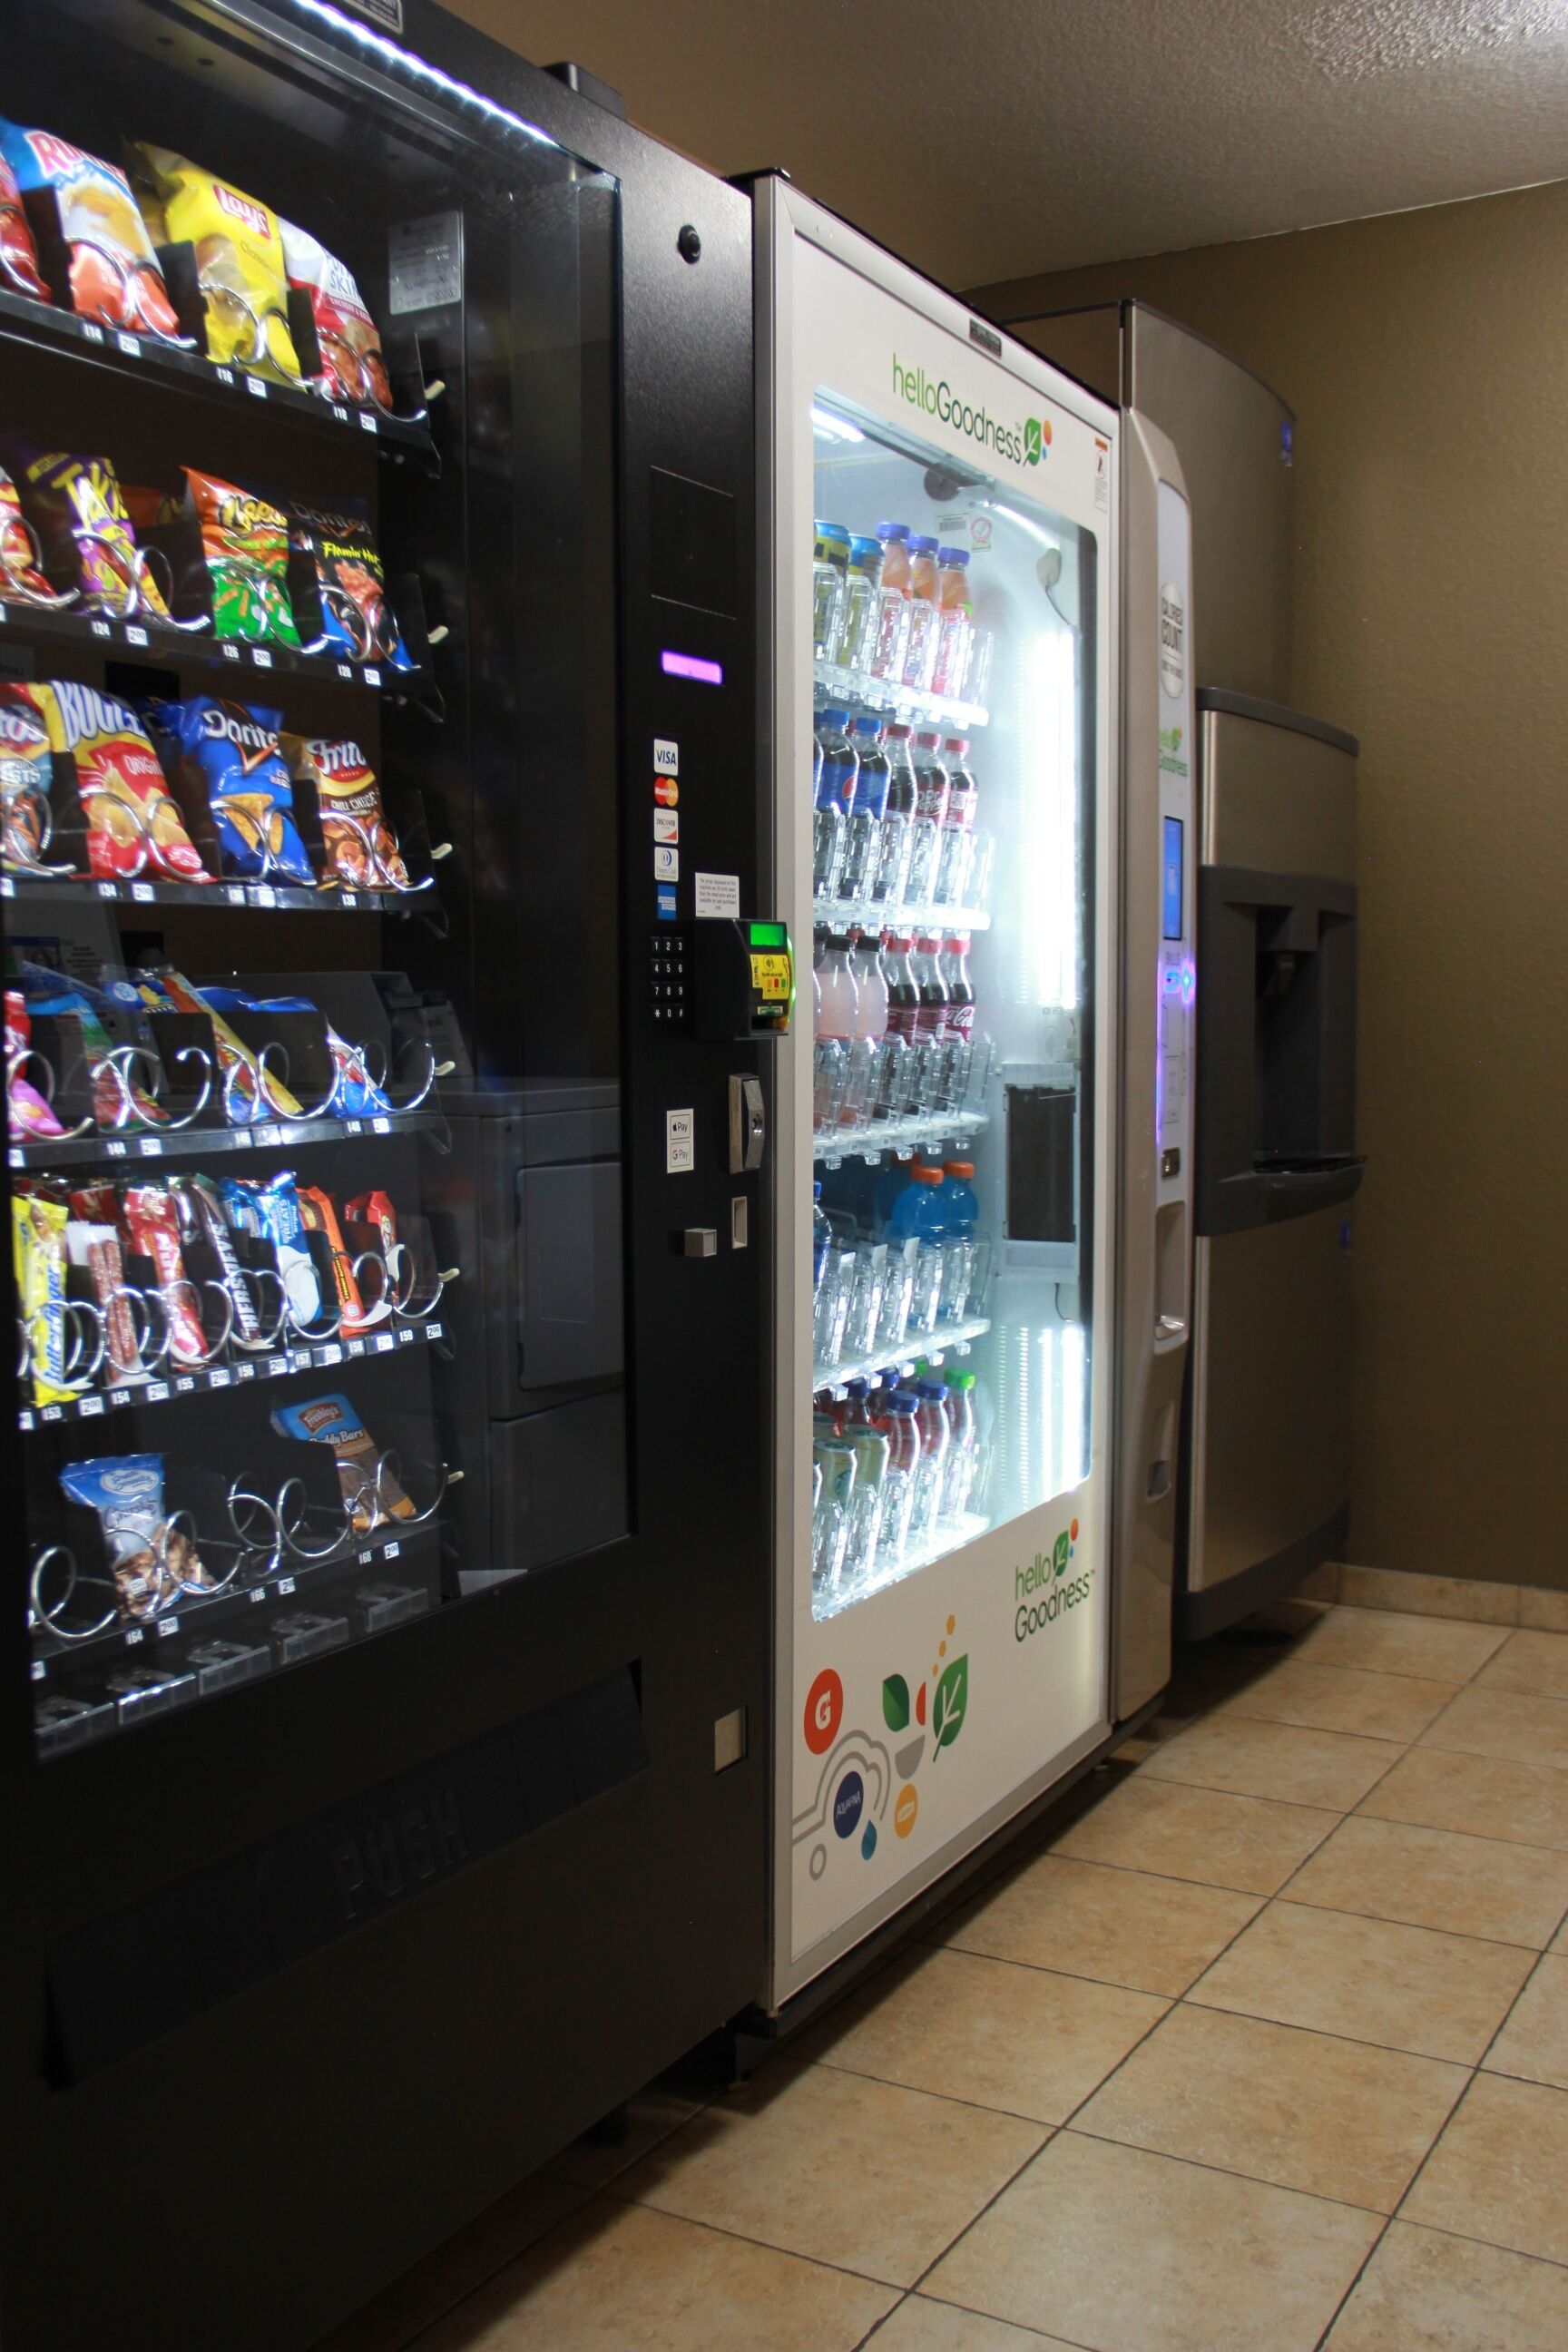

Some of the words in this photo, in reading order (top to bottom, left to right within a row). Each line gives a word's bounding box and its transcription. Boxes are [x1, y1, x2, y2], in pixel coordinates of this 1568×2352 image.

[220, 185, 269, 235] Lay's
[216, 366, 234, 384] 116
[333, 405, 348, 421] 118
[52, 681, 150, 751] BUGLE
[306, 740, 368, 776] Frito
[656, 749, 677, 766] VISA
[656, 818, 676, 828] DISCOVER
[341, 894, 357, 906] 138
[654, 942, 659, 951] 1
[666, 942, 671, 951] 2
[678, 942, 682, 951] 3
[654, 964, 660, 973] 4
[666, 964, 671, 973] 5
[678, 964, 682, 973] 6
[654, 986, 660, 995] 7
[666, 986, 671, 995] 8
[678, 986, 683, 995] 9
[667, 1008, 671, 1018] 0
[677, 1122, 689, 1133] Pay
[672, 1149, 679, 1161] G
[679, 1149, 690, 1161] Pay
[399, 1329, 414, 1342] 159
[348, 1341, 363, 1354] 158
[238, 1364, 255, 1378] 156
[111, 1390, 131, 1406] 154
[44, 1406, 64, 1421] 153
[340, 1427, 364, 1442] Bars
[358, 1552, 373, 1565] 168
[1014, 1552, 1052, 1602] hello
[250, 1588, 266, 1603] 166
[1014, 1572, 1090, 1643] Goodness
[125, 1629, 143, 1644] 164
[836, 1790, 862, 1819] AQUAFINA
[329, 1788, 471, 1920] PUSH
